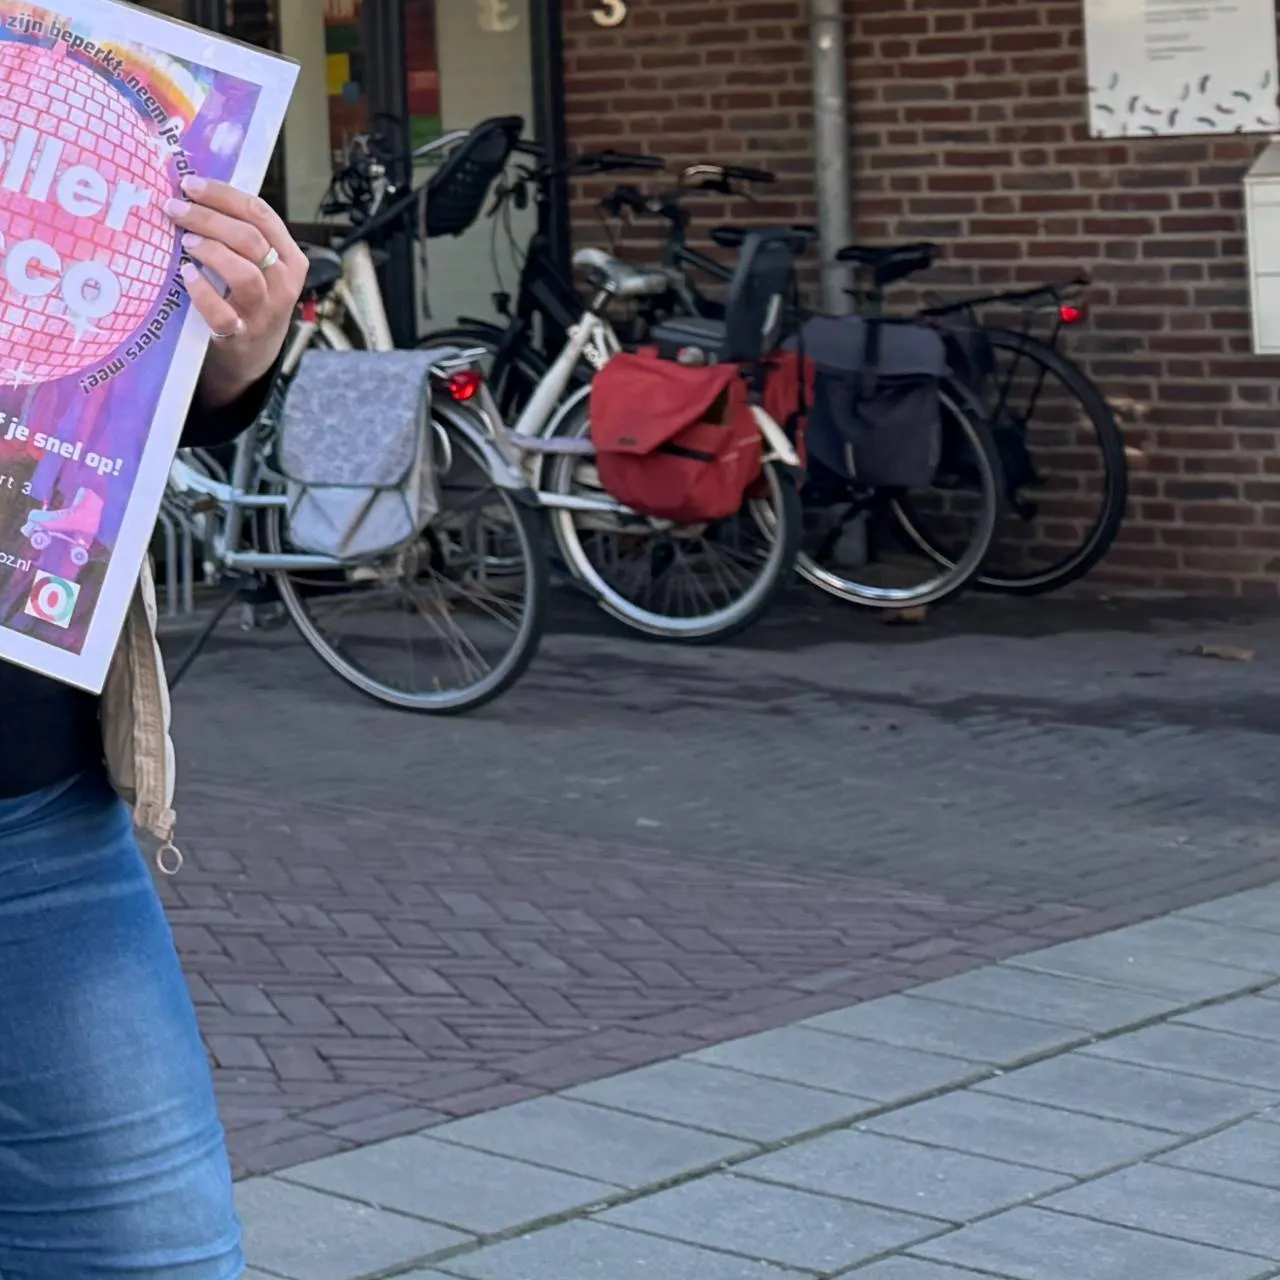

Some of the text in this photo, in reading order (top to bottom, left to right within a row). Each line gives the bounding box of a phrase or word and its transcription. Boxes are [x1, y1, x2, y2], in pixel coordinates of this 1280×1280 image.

[7, 12, 43, 34] zijn
[49, 21, 125, 79] beperkt,
[126, 75, 169, 127] neem
[158, 124, 179, 146] je
[79, 357, 126, 395] mee!
[3, 417, 30, 441] je
[33, 431, 84, 462] snel
[84, 451, 124, 477] op!
[21, 481, 33, 495] 3
